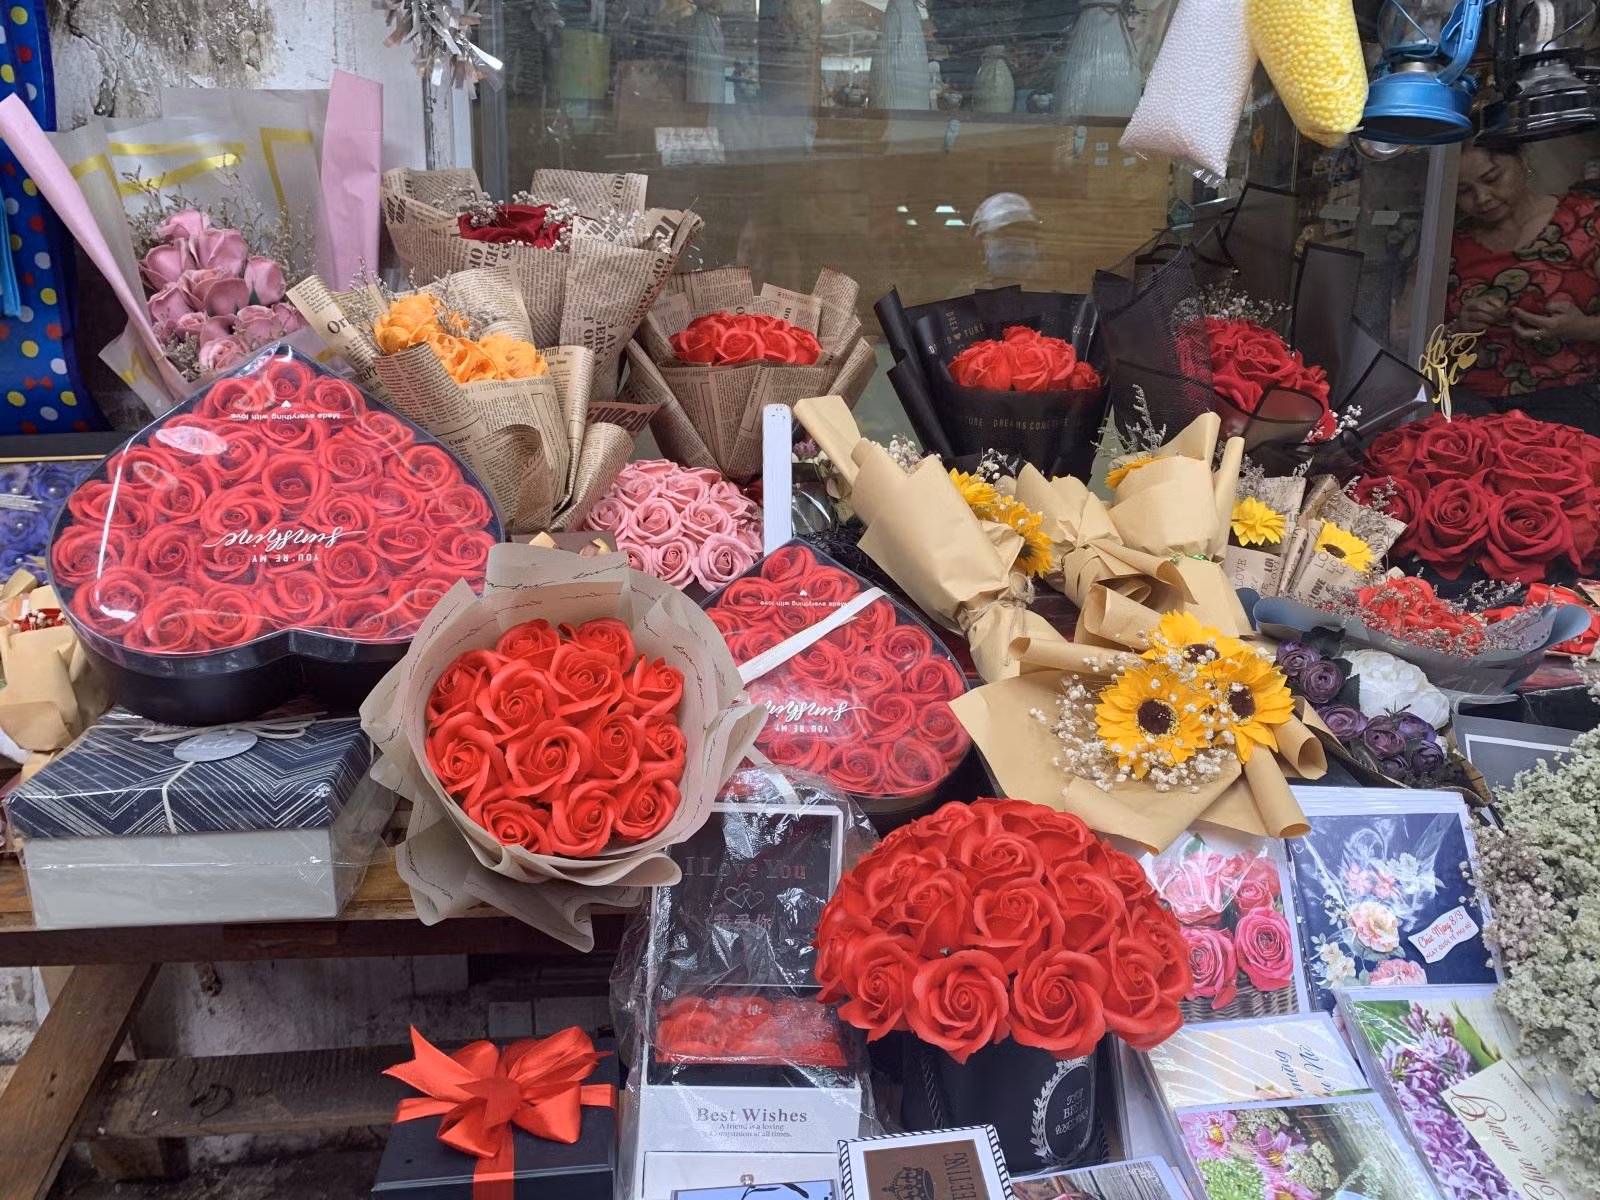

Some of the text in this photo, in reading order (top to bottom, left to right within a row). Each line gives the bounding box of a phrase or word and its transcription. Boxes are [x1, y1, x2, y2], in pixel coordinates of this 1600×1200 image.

[271, 412, 315, 421] everything
[448, 434, 472, 446] Center
[201, 526, 367, 552] sunshine
[252, 553, 319, 563] YOU'RE MY
[1235, 558, 1247, 589] LOVE
[764, 700, 870, 722] sunshin
[775, 724, 829, 734] YOU'RE MY
[763, 859, 806, 880] You
[1448, 910, 1464, 926] 8/3
[697, 1107, 808, 1122] Best Wishes
[762, 1123, 785, 1131] loving
[943, 1152, 977, 1200] EETING
